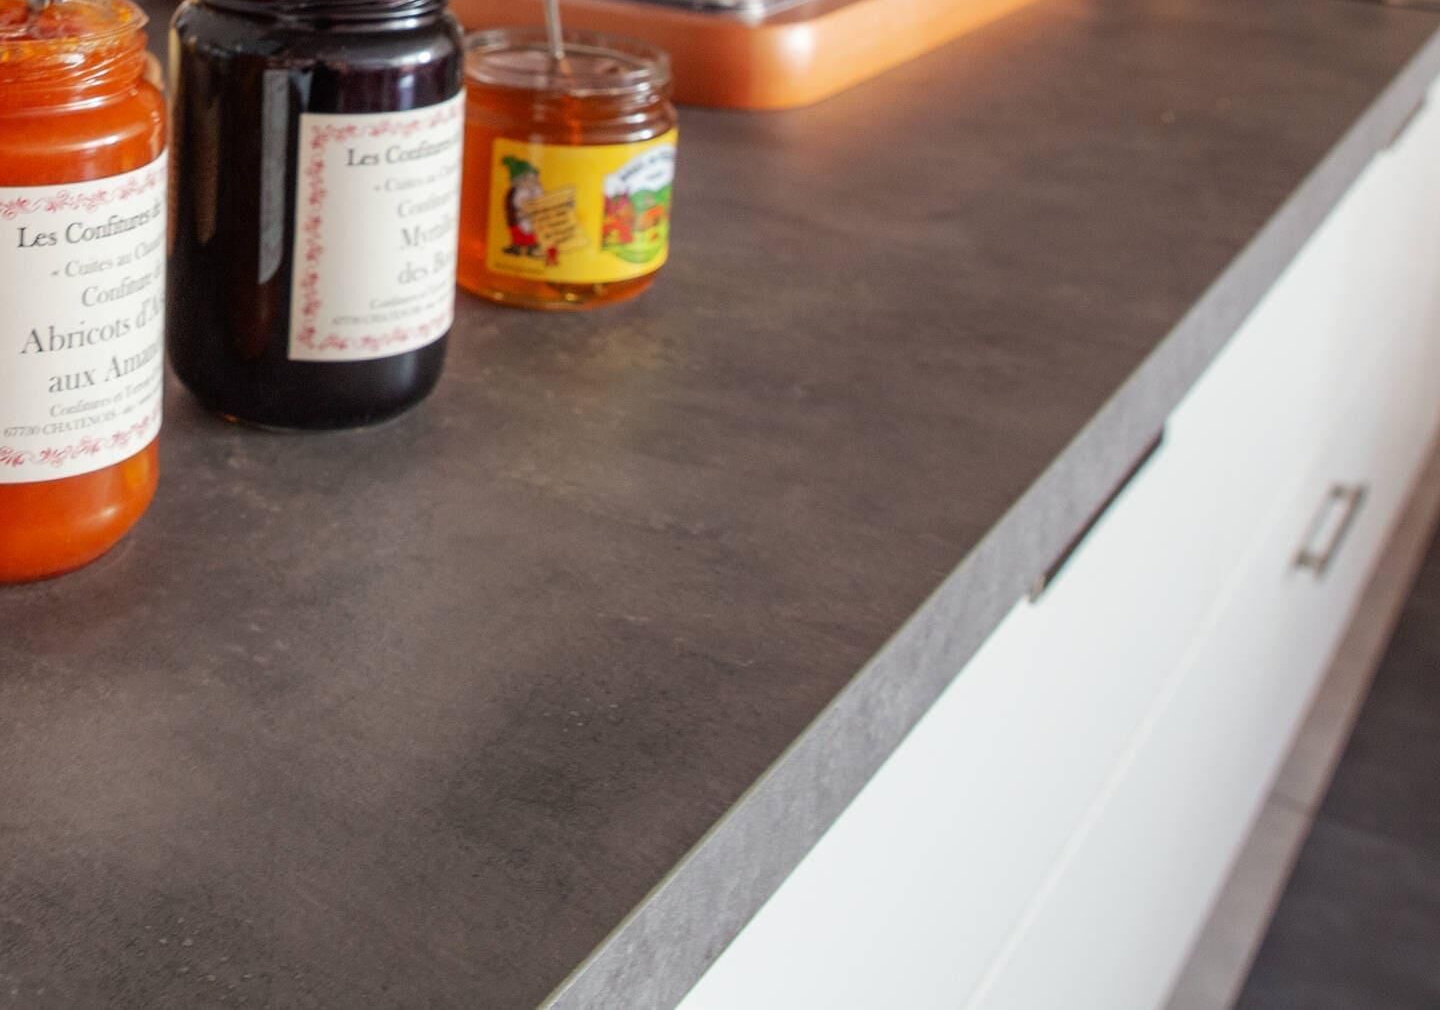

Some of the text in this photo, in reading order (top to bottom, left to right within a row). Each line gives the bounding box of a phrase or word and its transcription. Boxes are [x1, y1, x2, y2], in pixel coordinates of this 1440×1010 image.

[344, 147, 379, 166] Les
[17, 226, 58, 248] Les
[65, 209, 150, 245] Confitures
[19, 318, 131, 355] Abricots
[48, 368, 96, 393] aux
